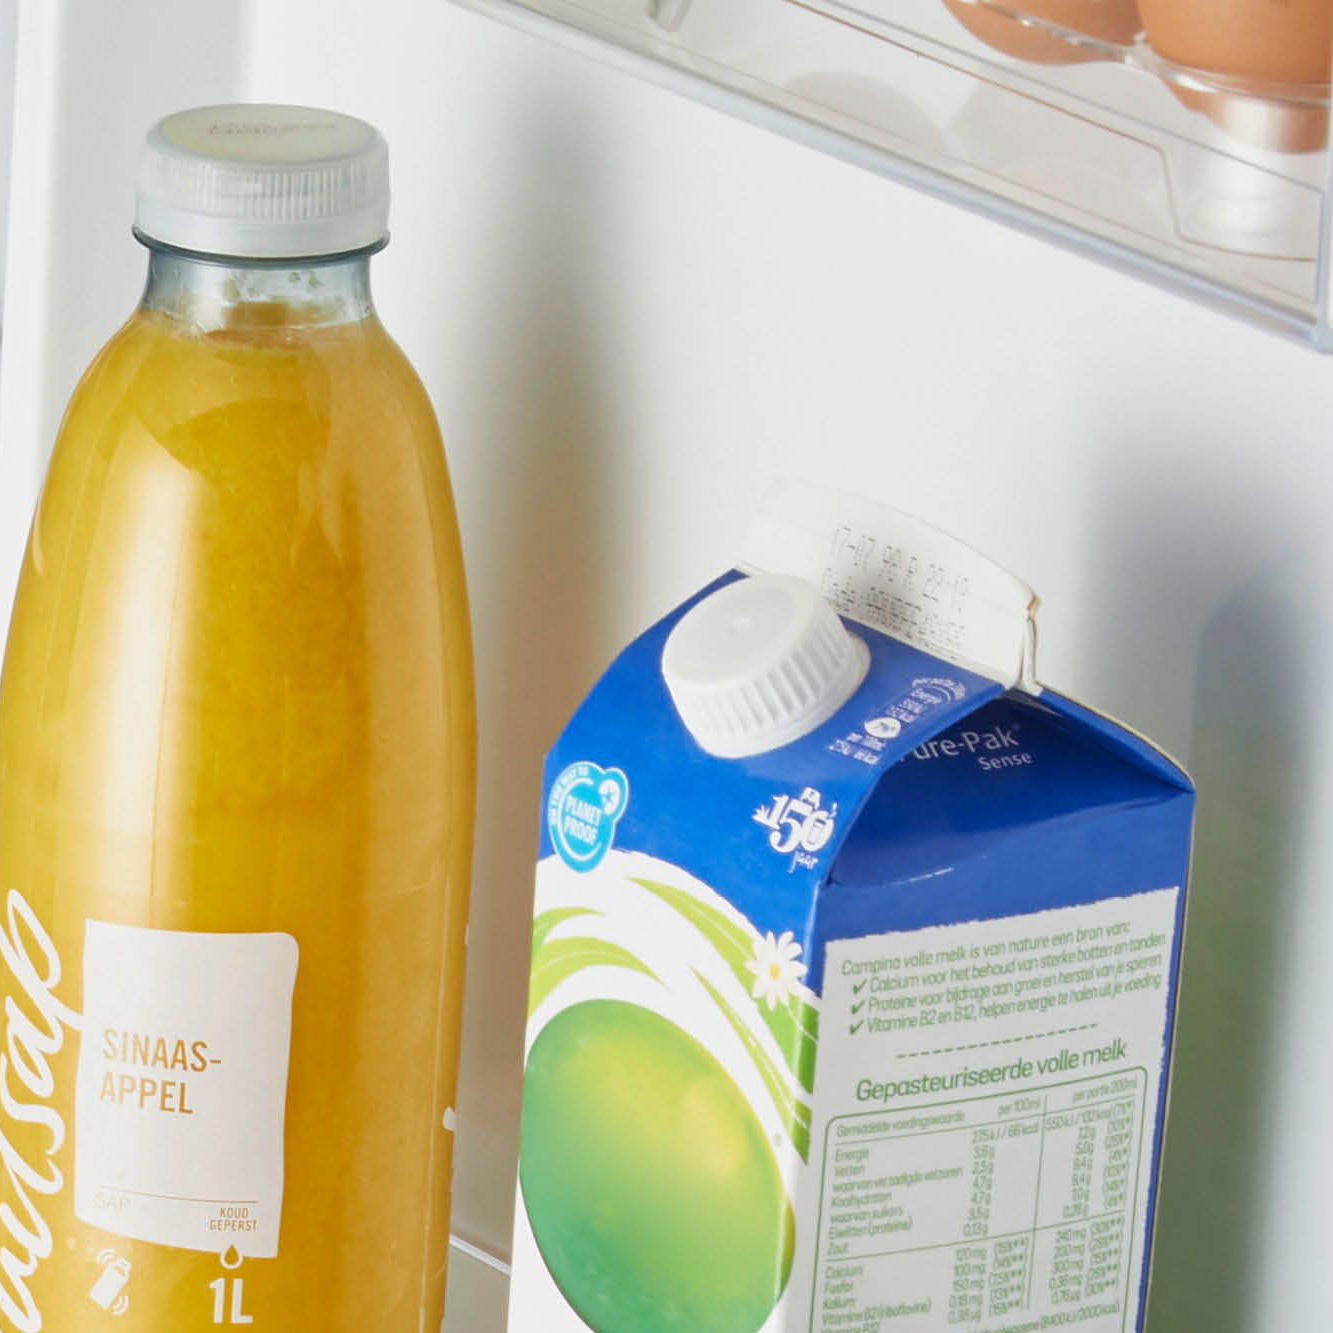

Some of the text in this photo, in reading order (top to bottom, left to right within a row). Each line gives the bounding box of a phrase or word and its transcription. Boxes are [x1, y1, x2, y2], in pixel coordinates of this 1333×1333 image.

[978, 751, 1033, 771] Sense
[565, 815, 598, 845] PROOF
[788, 851, 819, 874] jaar
[904, 949, 933, 967] volle
[936, 943, 966, 962] melk
[102, 1028, 222, 1072] SINAAS-
[856, 1037, 1128, 1104] Gepasteuriseerde volle melk
[98, 1069, 195, 1115] APPEL
[209, 1219, 258, 1232] GEPERST
[220, 1207, 249, 1219] KOUD
[209, 1278, 254, 1324] 1L
